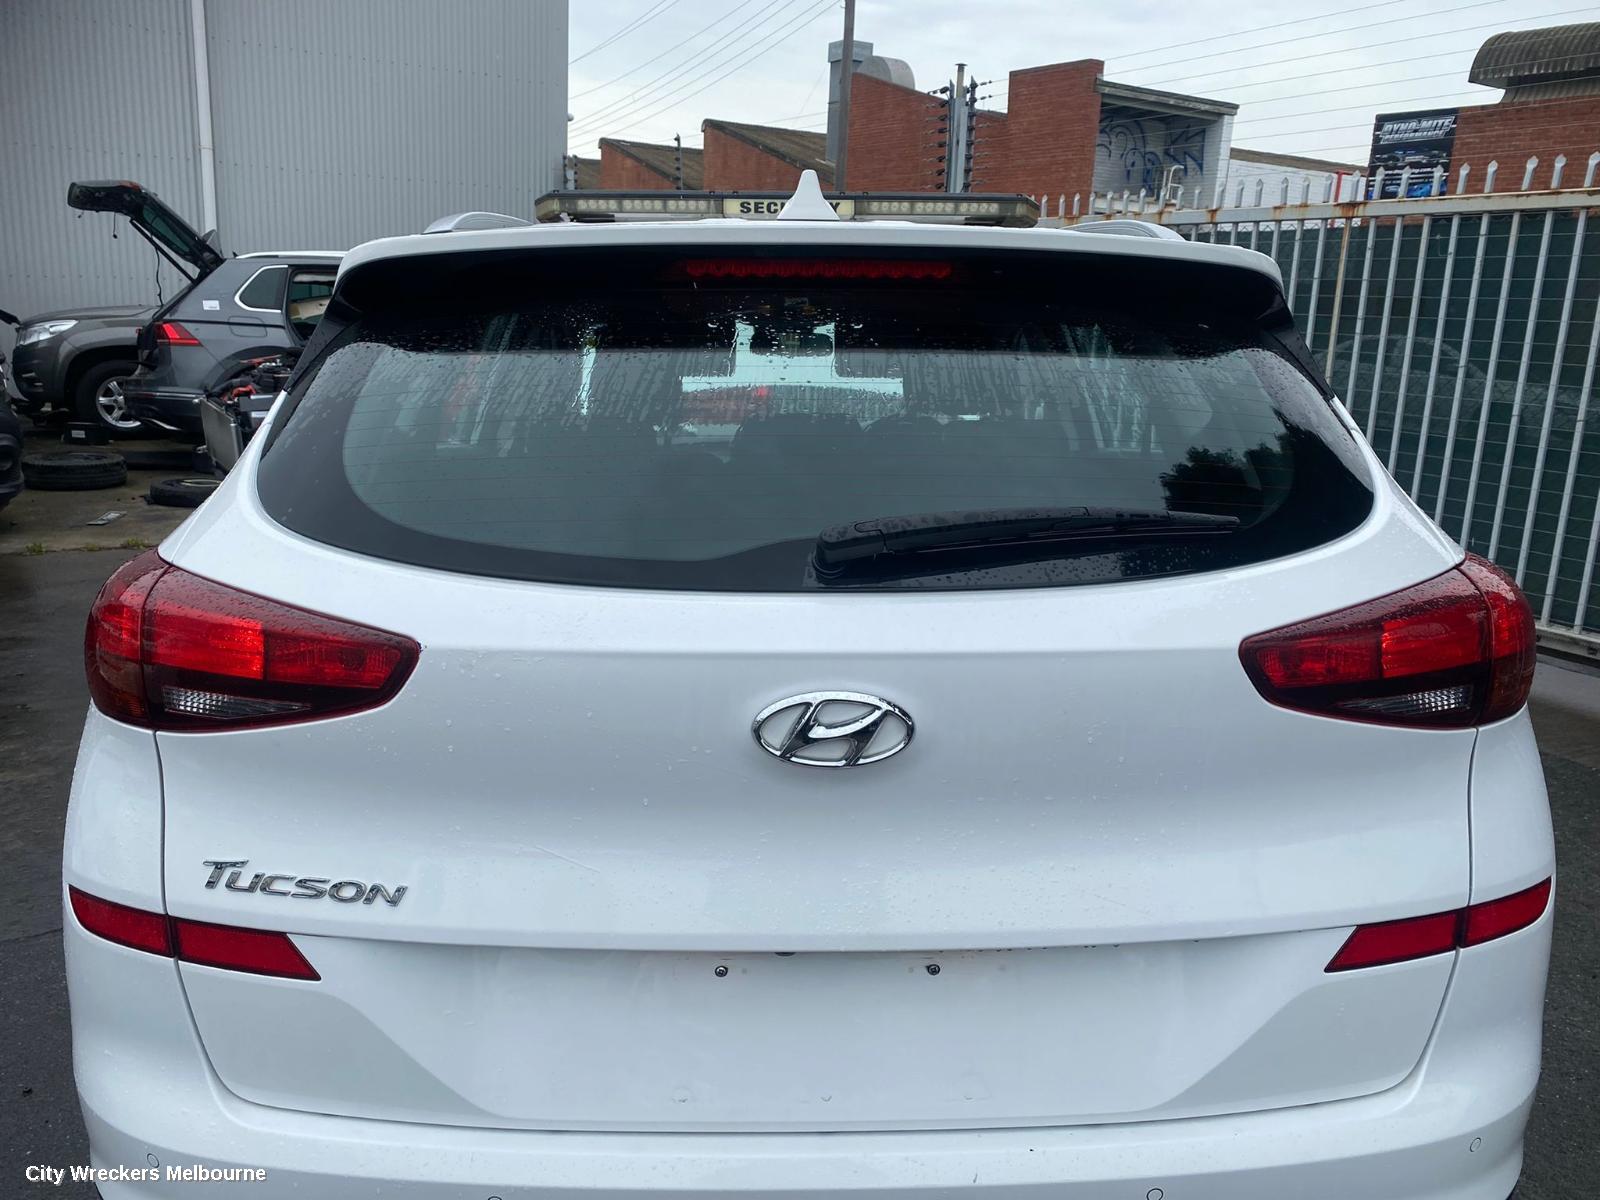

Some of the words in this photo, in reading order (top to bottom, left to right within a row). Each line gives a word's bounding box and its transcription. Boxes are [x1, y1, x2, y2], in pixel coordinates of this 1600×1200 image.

[1382, 118, 1453, 135] DYNO-MITE
[739, 201, 841, 214] SECY
[202, 859, 408, 907] TUCSON
